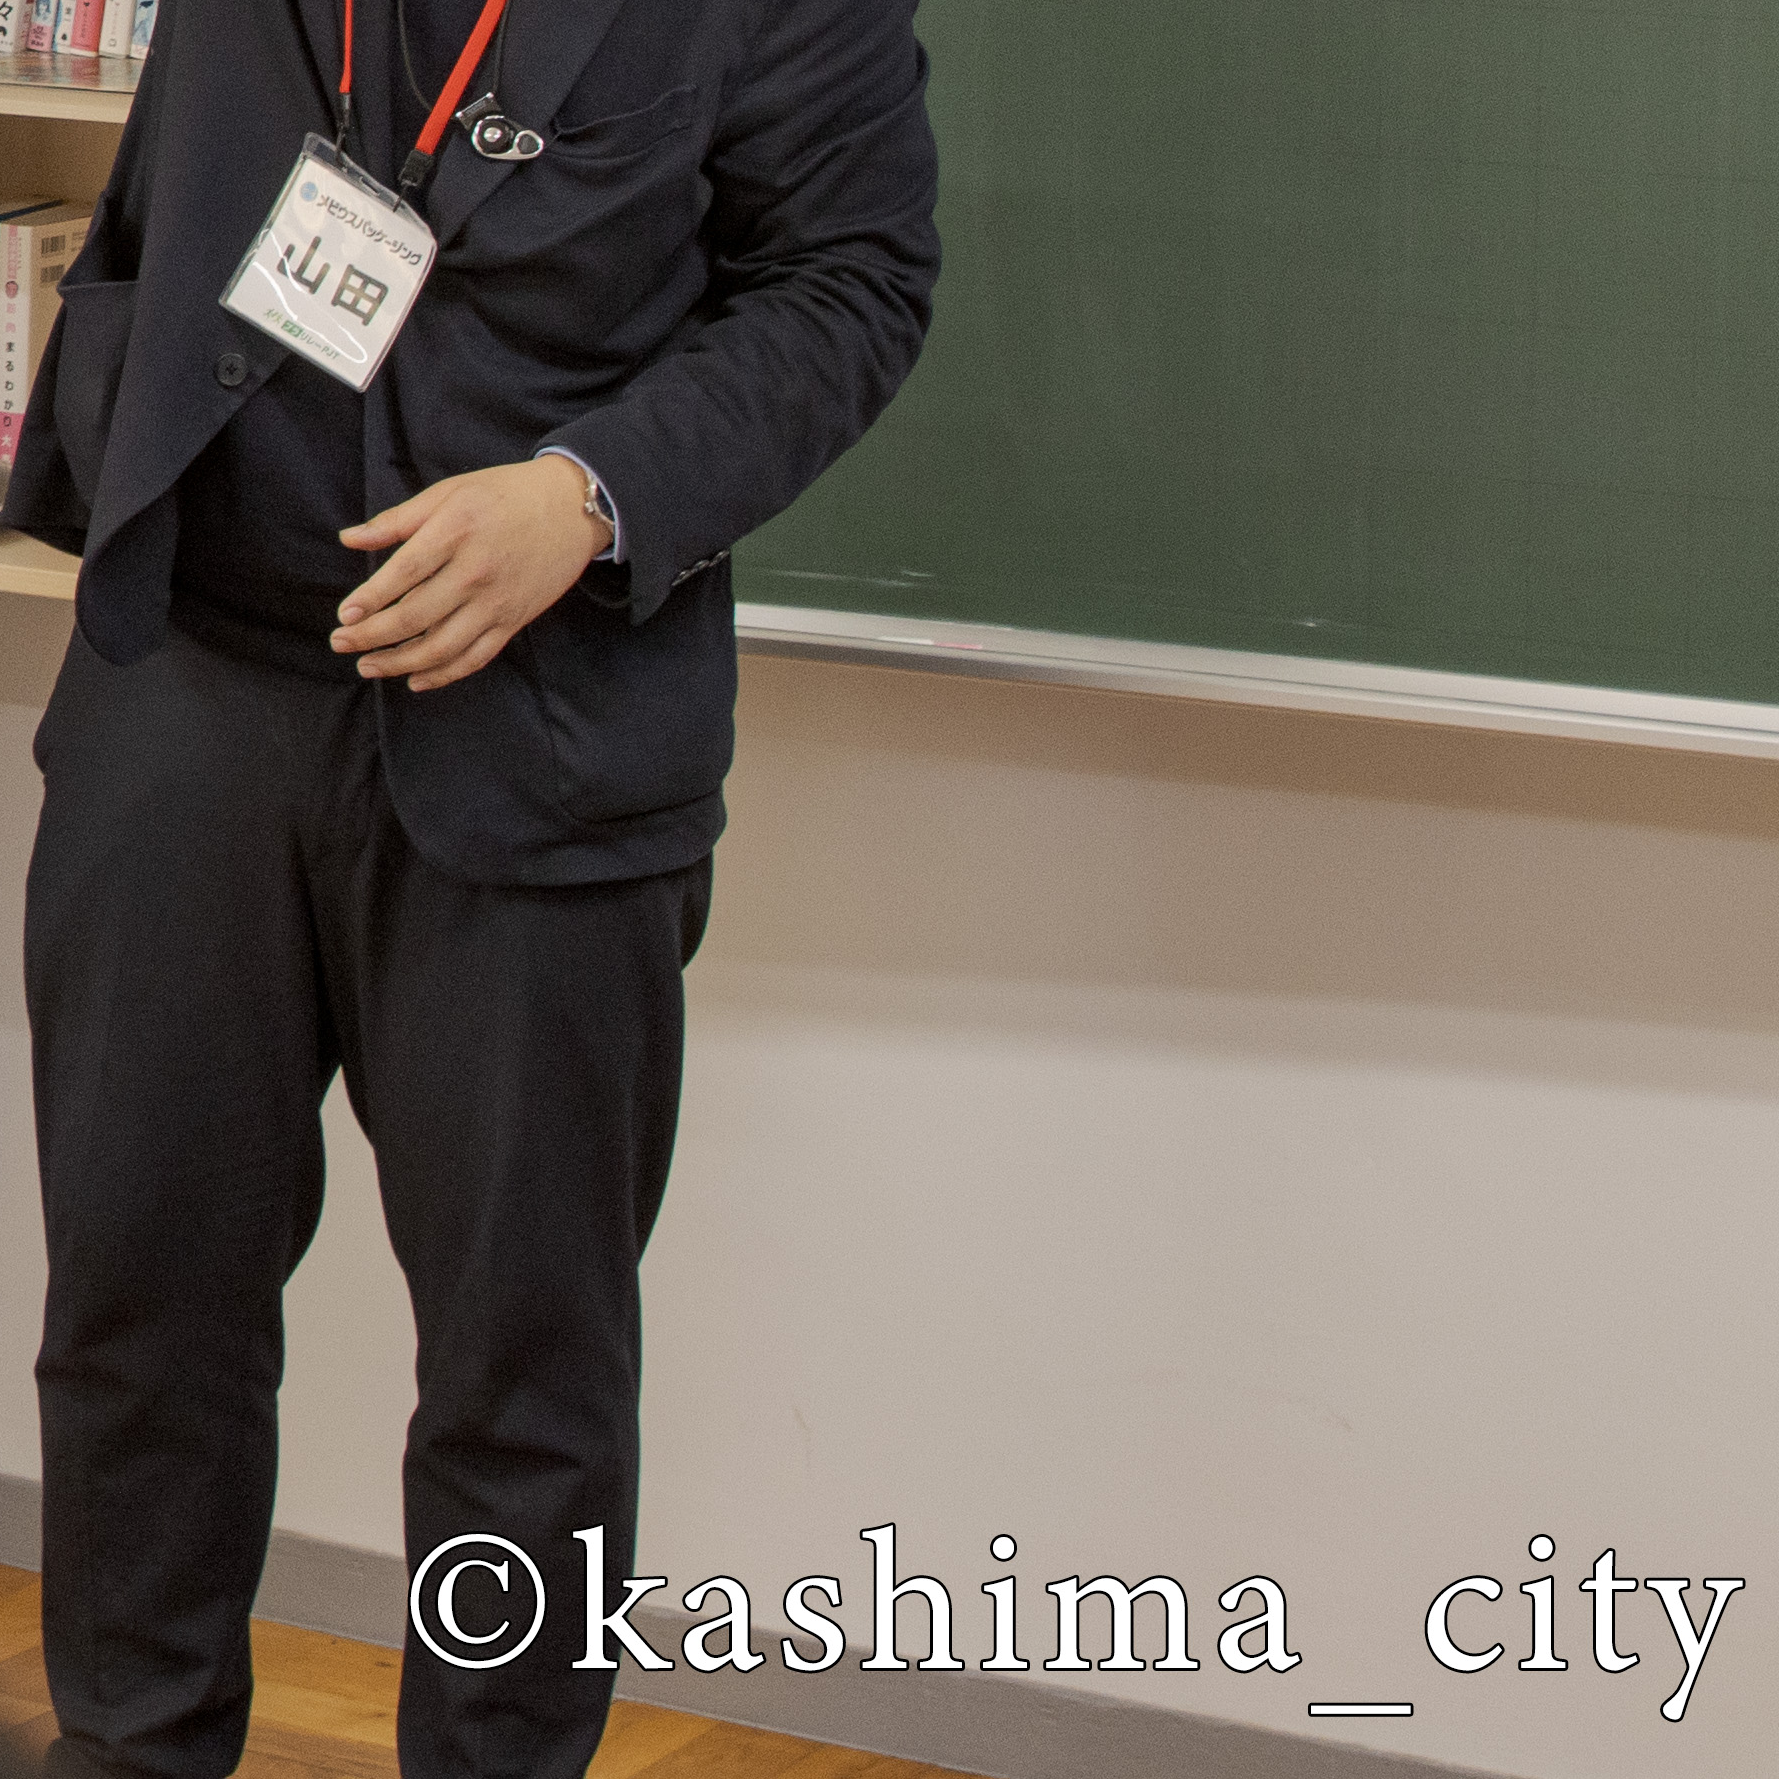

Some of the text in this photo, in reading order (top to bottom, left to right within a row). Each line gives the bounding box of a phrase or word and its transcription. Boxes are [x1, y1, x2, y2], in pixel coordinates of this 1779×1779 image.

[316, 194, 424, 266] メビウスパッケージング
[276, 235, 390, 327] 山田
